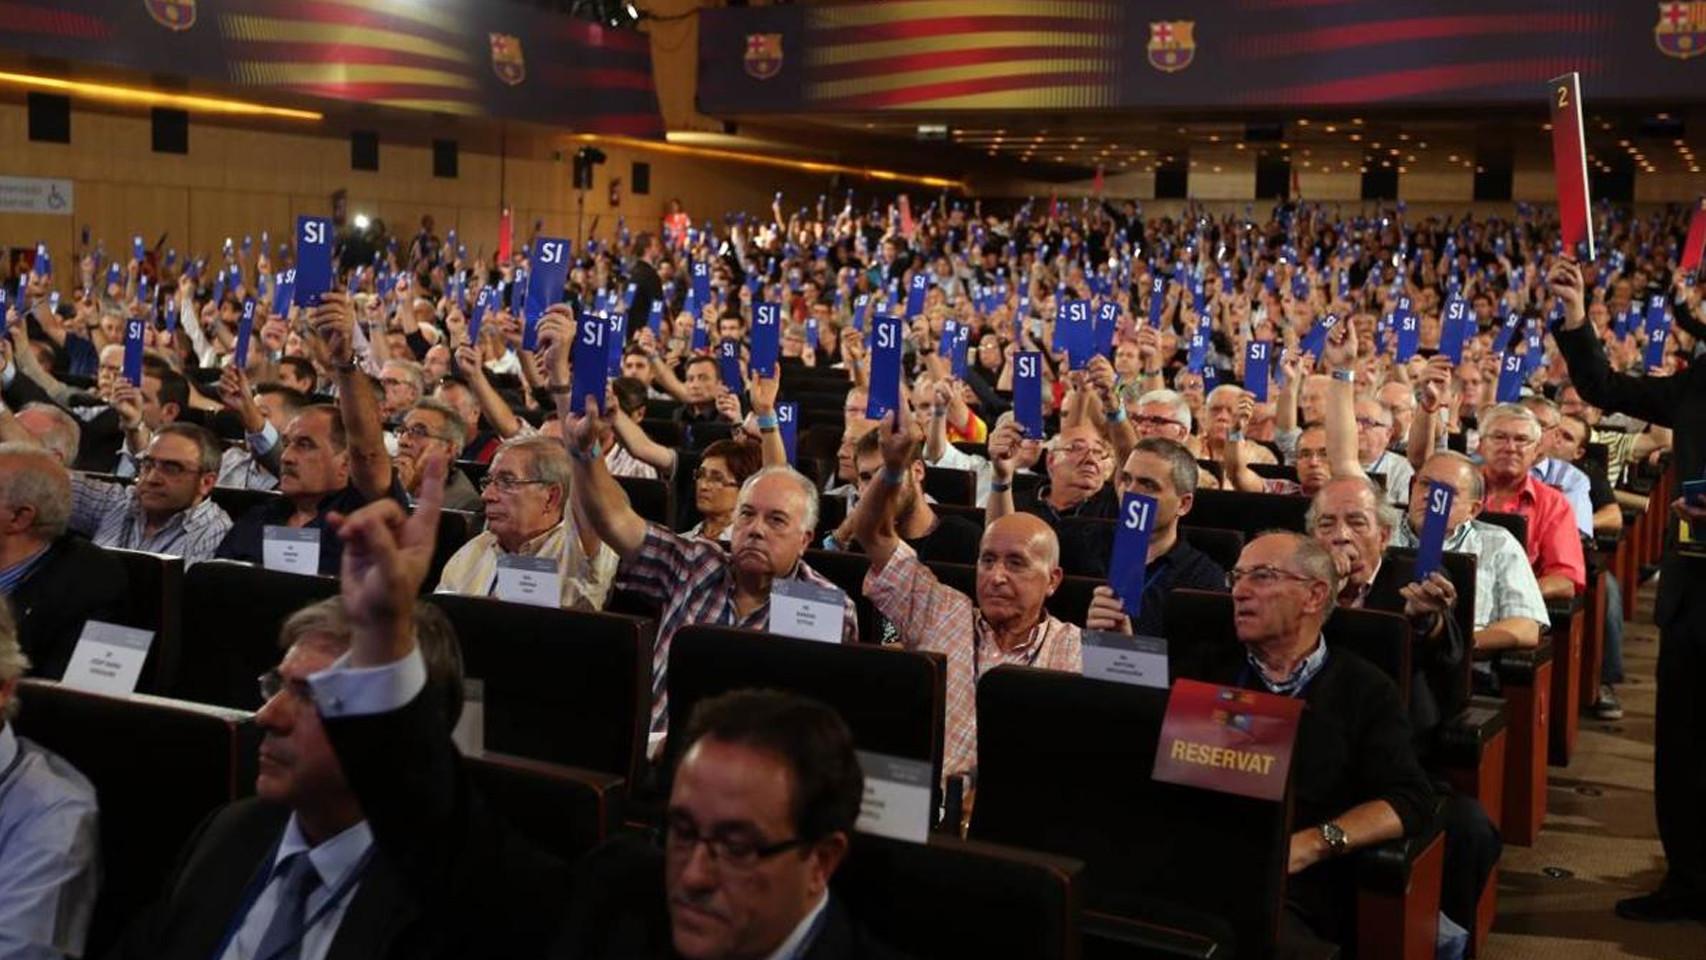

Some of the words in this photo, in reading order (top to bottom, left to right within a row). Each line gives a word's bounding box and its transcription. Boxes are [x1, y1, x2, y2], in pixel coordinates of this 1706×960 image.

[1558, 86, 1569, 108] 2
[304, 221, 325, 244] SI
[540, 242, 563, 264] SI
[285, 269, 296, 284] SI
[694, 263, 706, 276] SI
[913, 275, 925, 289] SI
[1153, 279, 1163, 293] SI
[653, 301, 662, 313] SI
[1652, 295, 1664, 308] SI
[243, 302, 253, 319] SI
[757, 305, 774, 325] SI
[1070, 303, 1086, 322] SI
[1101, 304, 1115, 321] SI
[1449, 302, 1464, 319] SI
[610, 315, 623, 332] SI
[1402, 317, 1415, 331] SI
[1507, 314, 1518, 328] SI
[129, 322, 141, 340] SI
[583, 321, 603, 347] SI
[877, 322, 895, 348] SI
[1652, 329, 1664, 342] SI
[1192, 335, 1203, 347] SI
[1529, 336, 1540, 347] SI
[723, 343, 734, 357] SI
[1251, 343, 1265, 360] SI
[1019, 356, 1035, 378] SI
[1204, 366, 1214, 378] SI
[1506, 356, 1521, 373] SI
[779, 405, 792, 422] SI
[1431, 488, 1448, 515] SI
[1125, 500, 1149, 531] SI
[1170, 739, 1276, 776] RESERVAT
